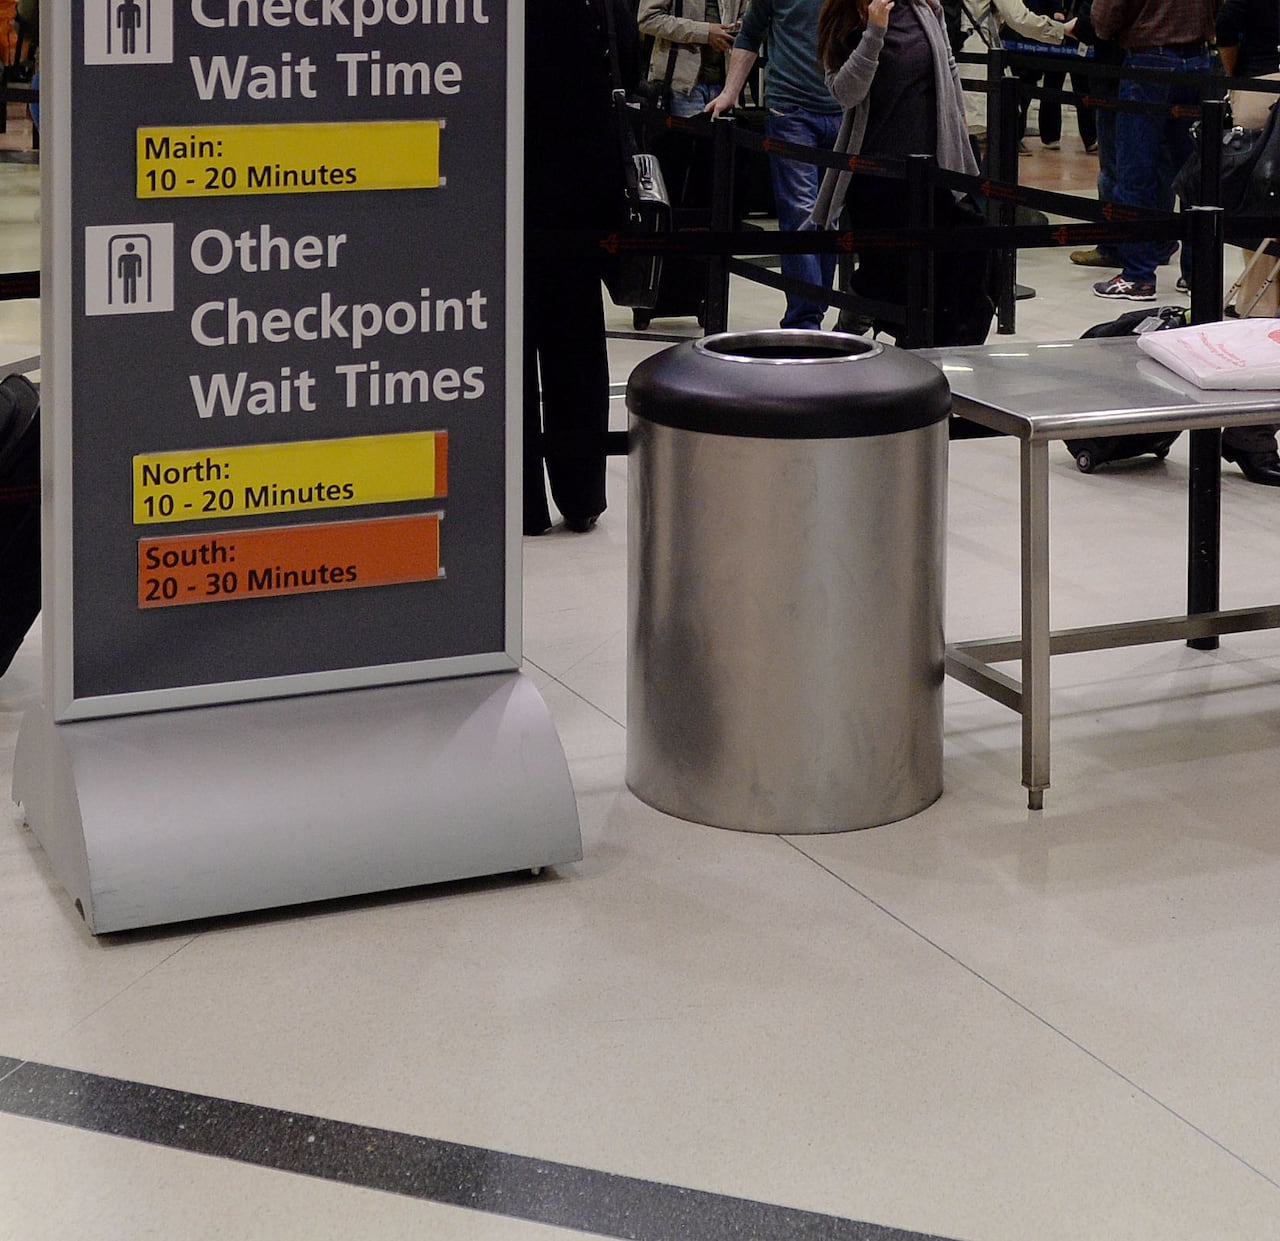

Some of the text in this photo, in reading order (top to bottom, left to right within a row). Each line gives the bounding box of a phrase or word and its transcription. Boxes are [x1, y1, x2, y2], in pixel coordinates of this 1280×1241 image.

[190, 50, 462, 100] Wait Time
[144, 136, 223, 160] Main:
[145, 169, 176, 192] 10
[204, 166, 237, 190] 20
[247, 164, 357, 188] Minutes
[190, 224, 347, 274] Other
[190, 288, 488, 348] Checkpoint
[189, 361, 486, 418] Wait Times
[141, 458, 230, 486] North:
[143, 494, 174, 517] 10
[202, 489, 234, 512] 20
[245, 480, 355, 509] Minutes
[145, 541, 236, 570] South:
[145, 577, 178, 601] 20
[205, 573, 238, 595] 30
[247, 563, 358, 592] Minutes
